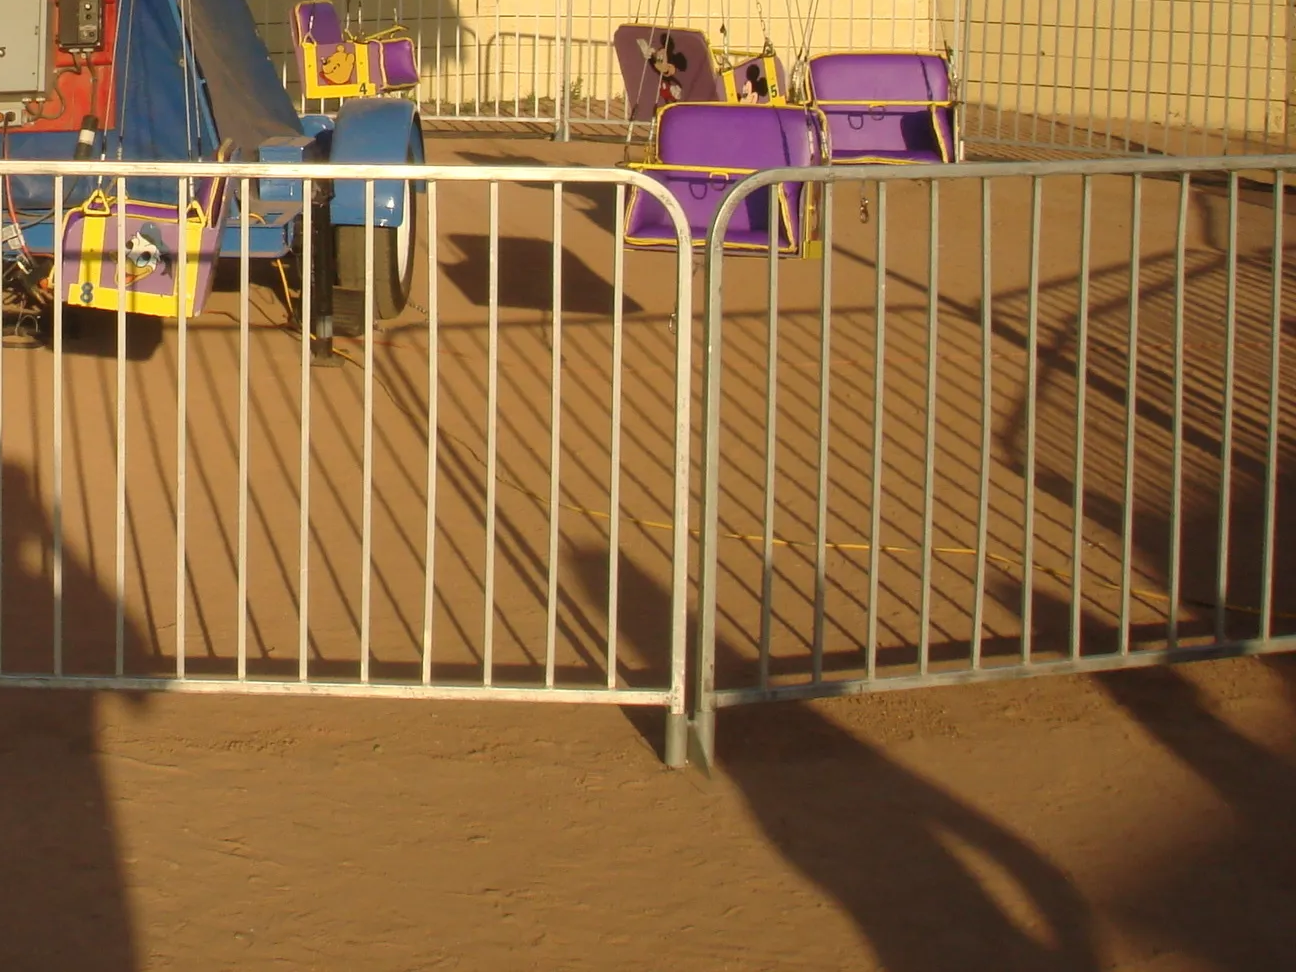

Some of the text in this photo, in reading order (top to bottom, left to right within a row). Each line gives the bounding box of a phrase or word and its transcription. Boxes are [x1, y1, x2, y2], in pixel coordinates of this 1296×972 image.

[358, 82, 368, 95] 4
[770, 84, 778, 98] 5
[80, 282, 94, 304] 8
